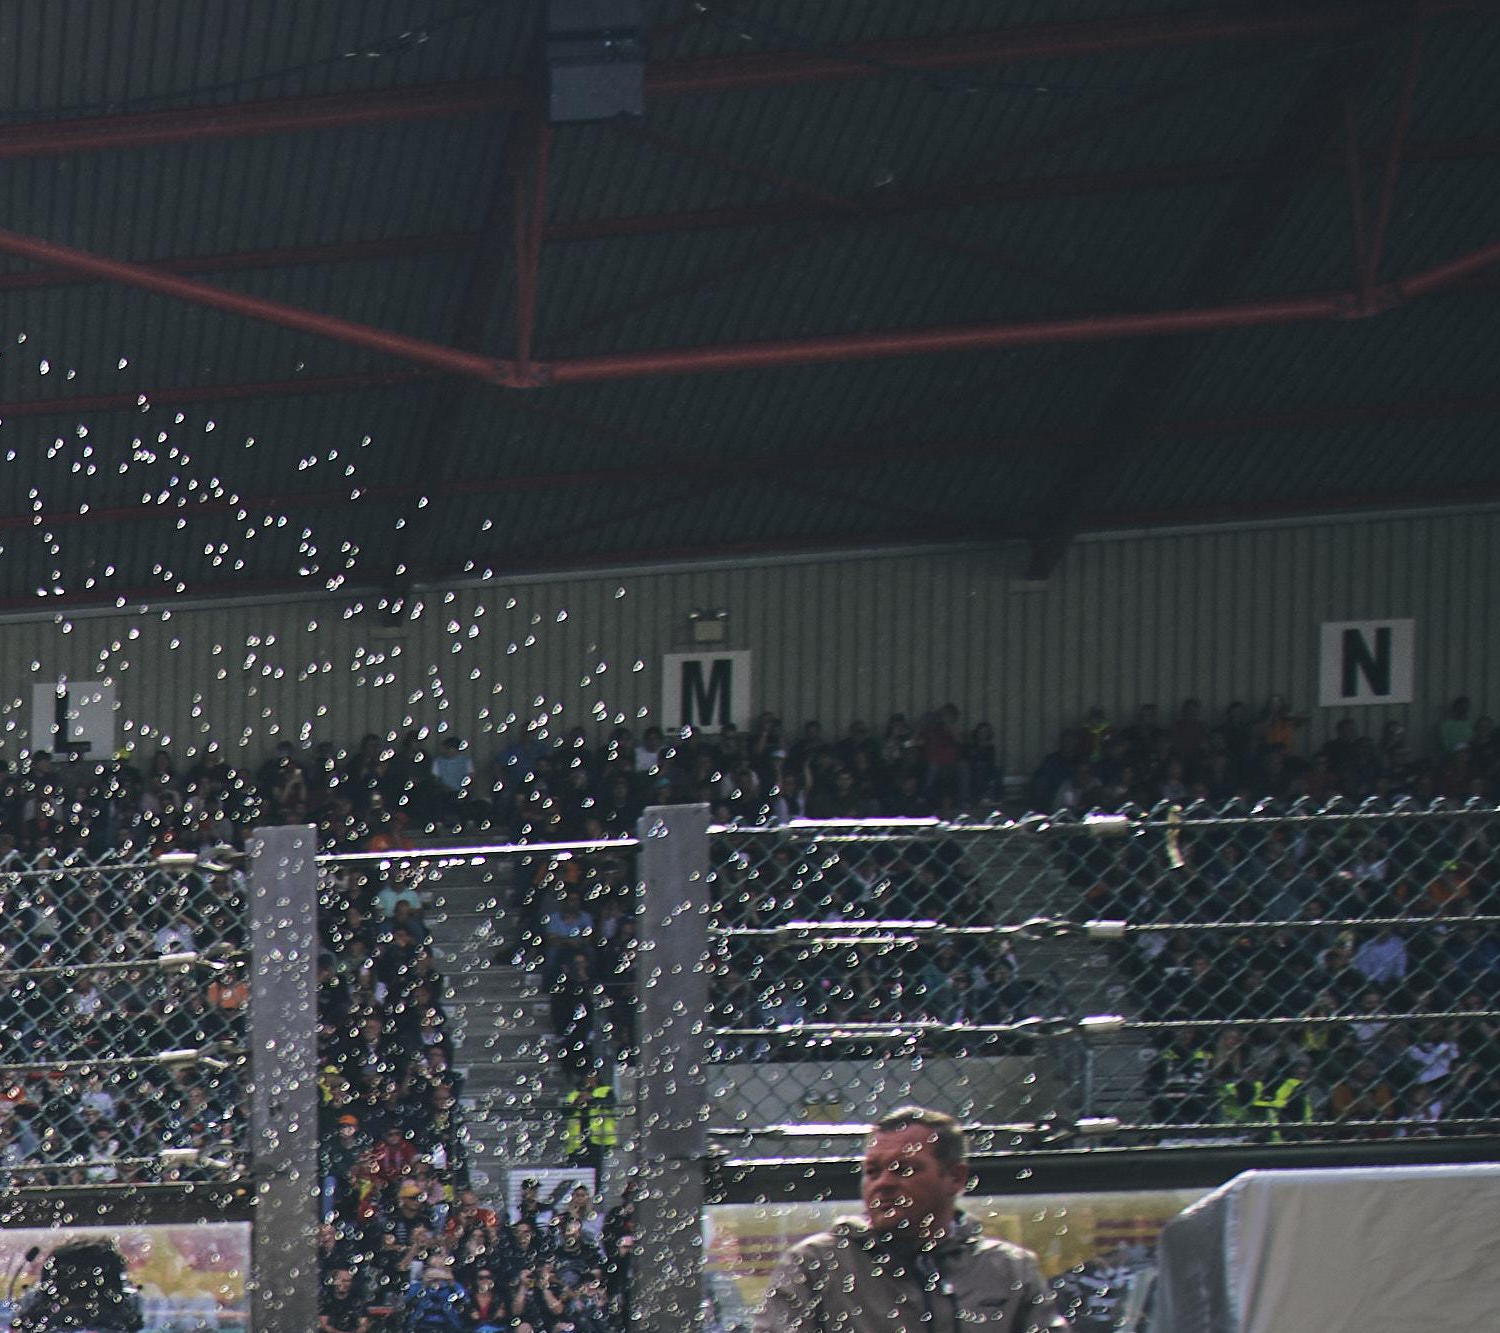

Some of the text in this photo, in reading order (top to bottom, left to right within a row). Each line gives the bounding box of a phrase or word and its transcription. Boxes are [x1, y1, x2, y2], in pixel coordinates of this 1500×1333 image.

[680, 658, 733, 728] M
[1341, 627, 1392, 697] N
[54, 688, 91, 754] L
